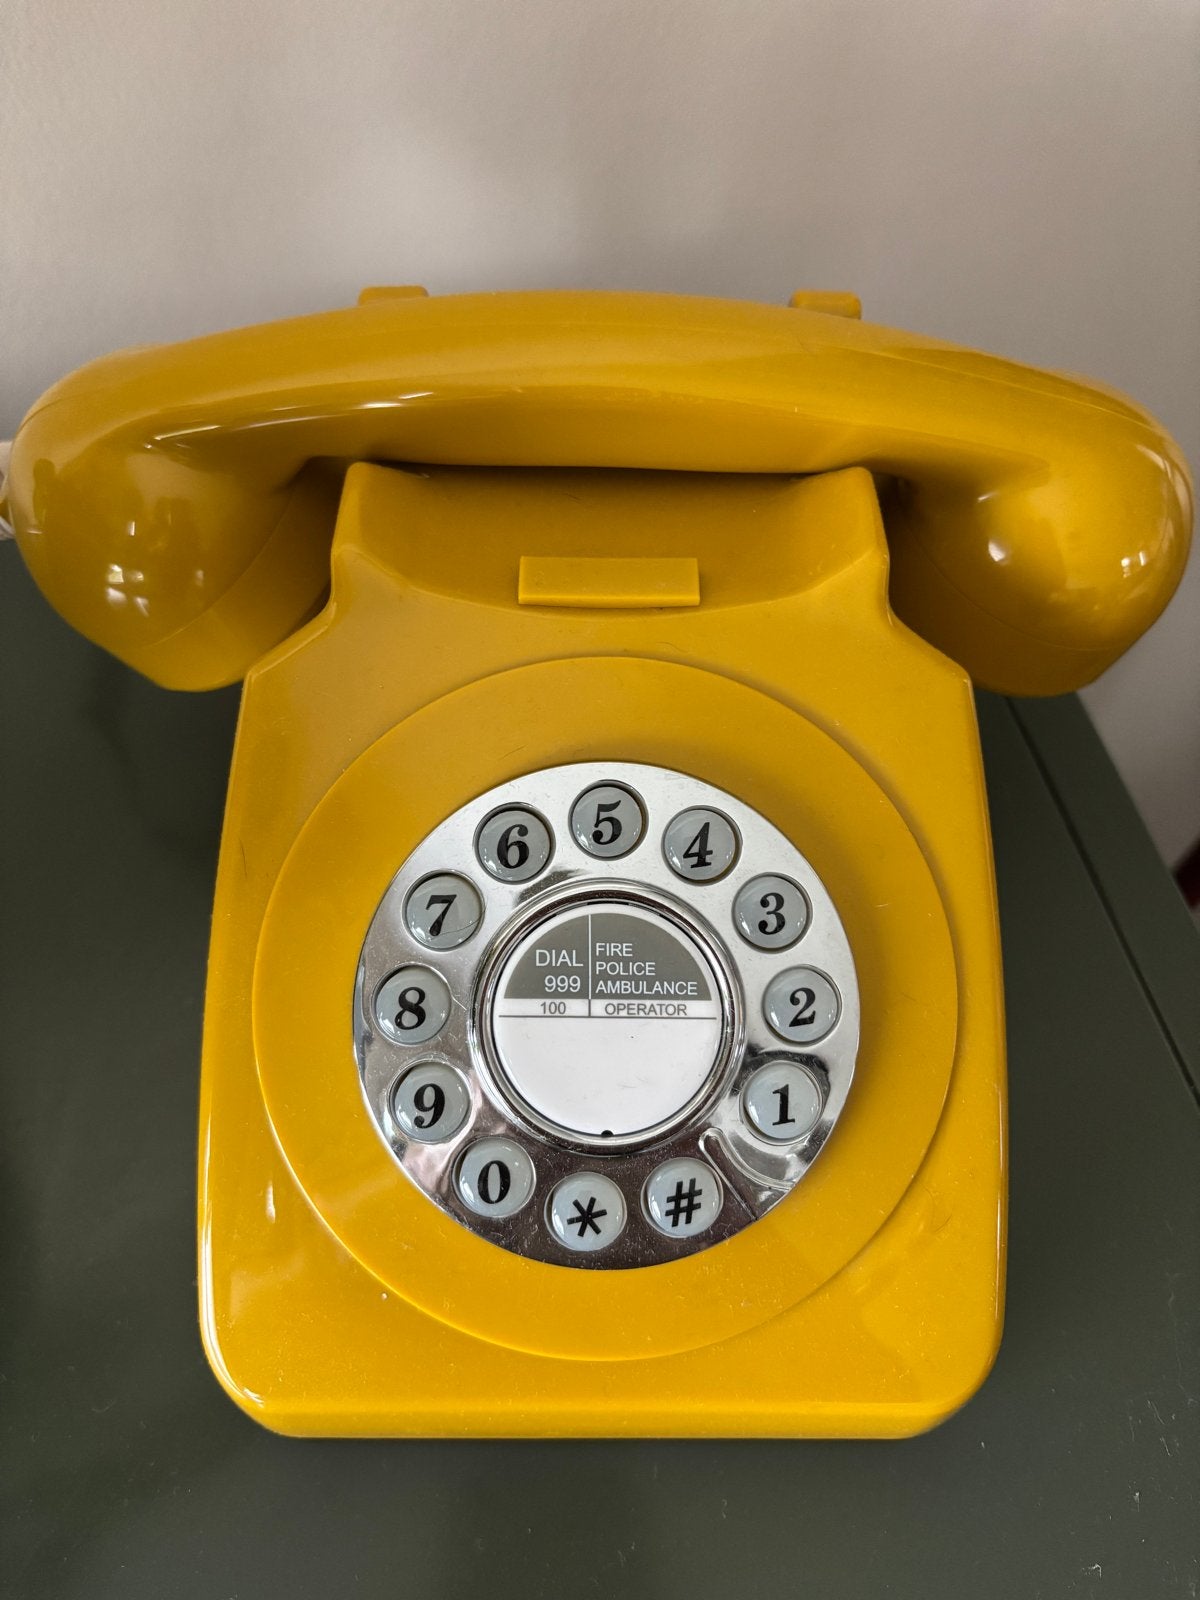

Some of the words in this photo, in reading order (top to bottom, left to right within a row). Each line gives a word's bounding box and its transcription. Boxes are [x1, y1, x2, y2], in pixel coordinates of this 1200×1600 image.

[592, 801, 621, 845] 5
[496, 824, 529, 868] 6
[683, 822, 713, 868] 4
[426, 894, 456, 936] 7
[758, 892, 786, 936] 3
[535, 950, 583, 966] DIAL
[596, 943, 633, 956] FIRE
[596, 962, 656, 976] POLICE
[545, 975, 580, 992] 999
[595, 981, 698, 995] AMBULANCE
[394, 986, 425, 1030] 8
[540, 1002, 566, 1015] 100
[605, 1003, 687, 1016] OPERATOR
[788, 987, 816, 1028] 2
[413, 1083, 445, 1128] 9
[771, 1084, 796, 1125] 1
[478, 1160, 510, 1205] 0
